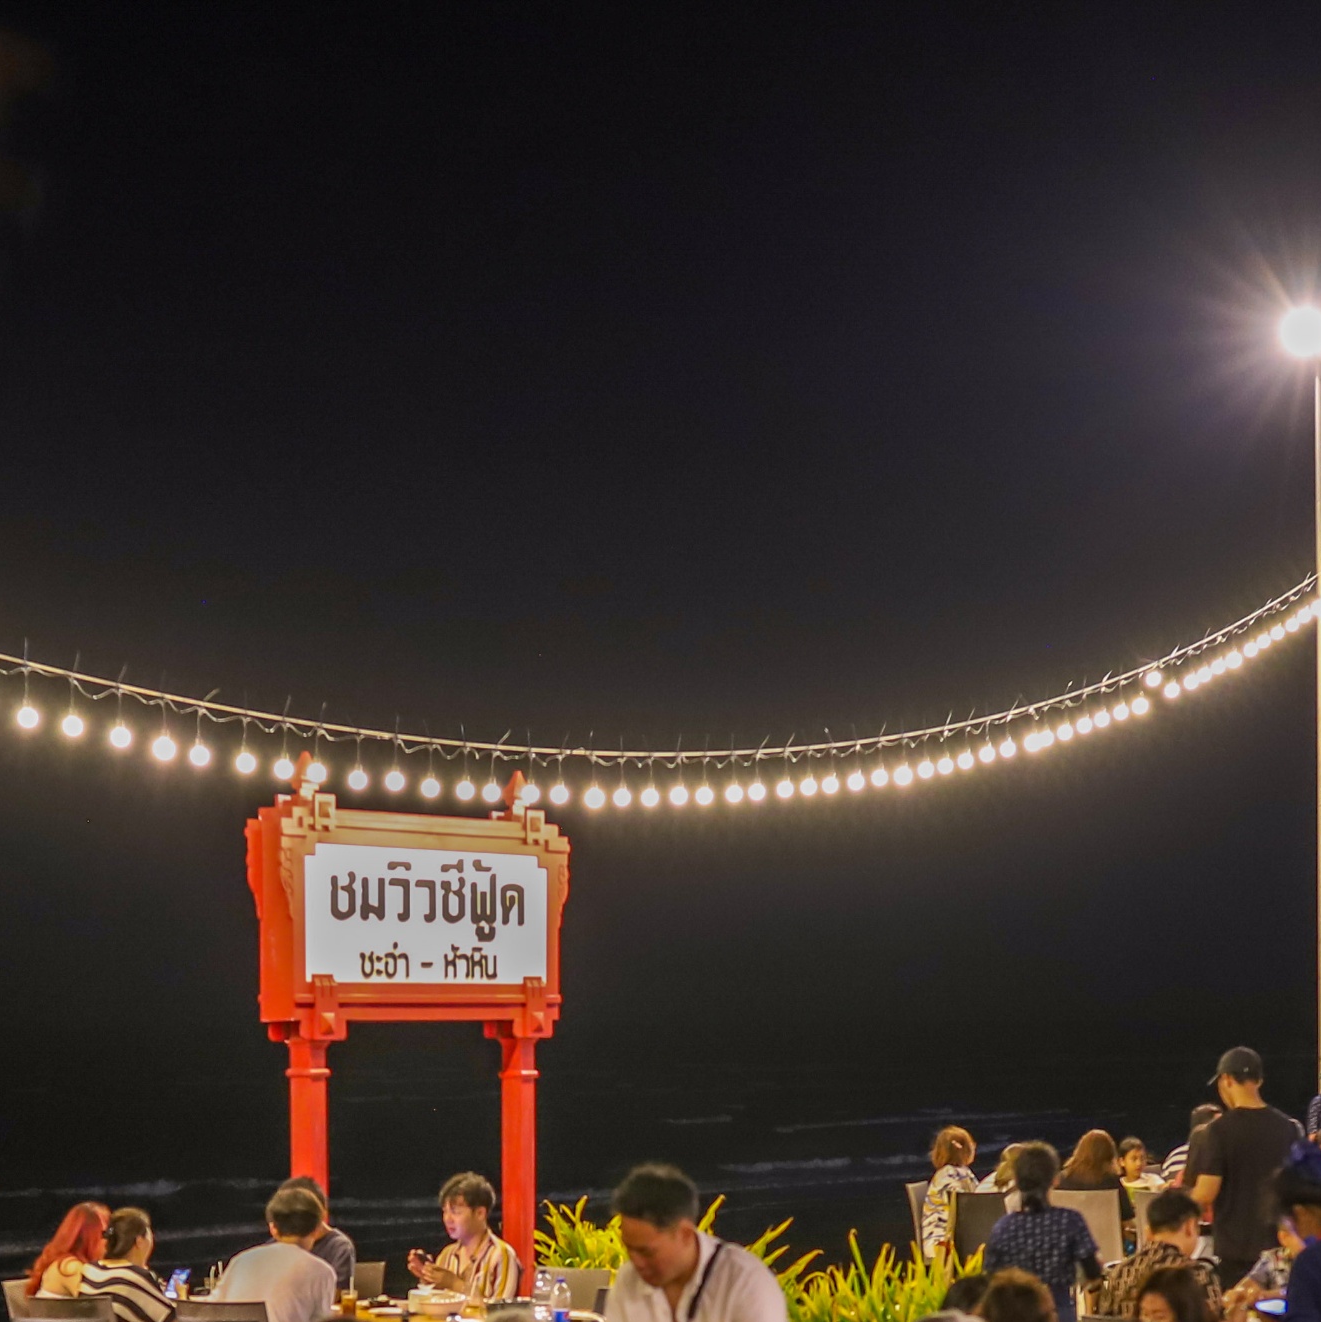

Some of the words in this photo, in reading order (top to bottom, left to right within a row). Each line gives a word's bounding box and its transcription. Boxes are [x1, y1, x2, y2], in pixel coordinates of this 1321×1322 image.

[330, 858, 525, 942] ชมวิวซีฟู้ด
[359, 941, 410, 979] ชะอำ
[443, 943, 498, 980] หัวหิน
